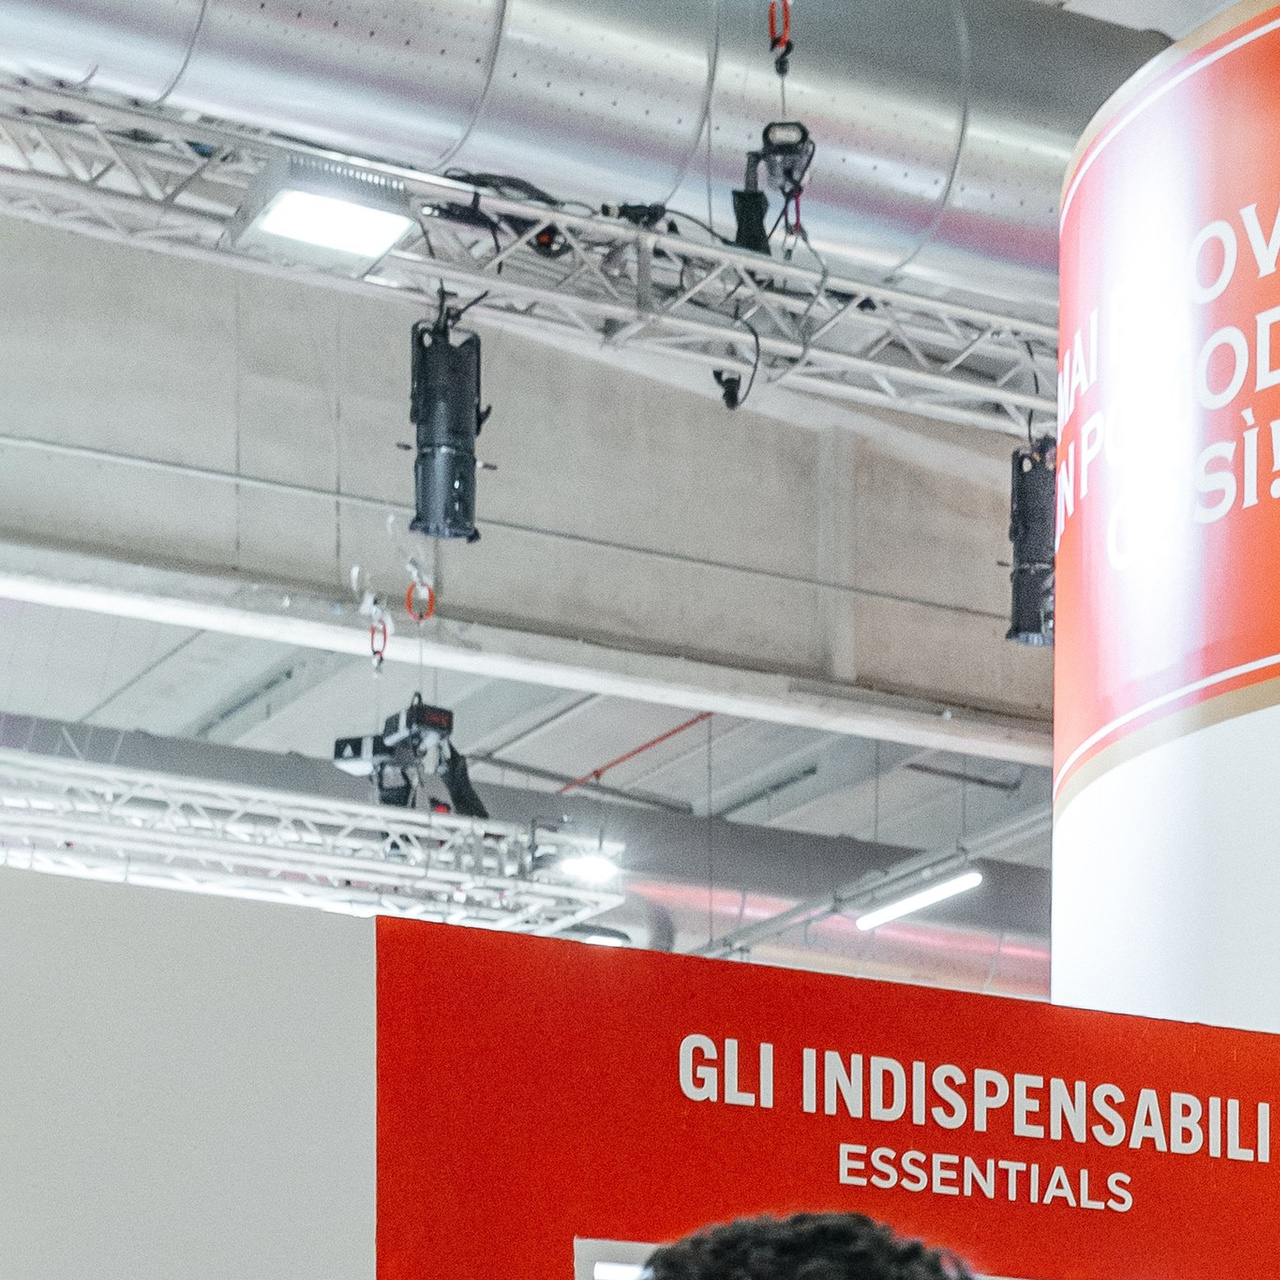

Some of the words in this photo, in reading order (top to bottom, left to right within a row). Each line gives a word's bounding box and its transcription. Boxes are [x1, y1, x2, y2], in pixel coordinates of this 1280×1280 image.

[677, 1033, 775, 1109] GLI
[802, 1047, 1271, 1164] INDISPENSABILI
[838, 1143, 1134, 1213] ESSENTIALS
